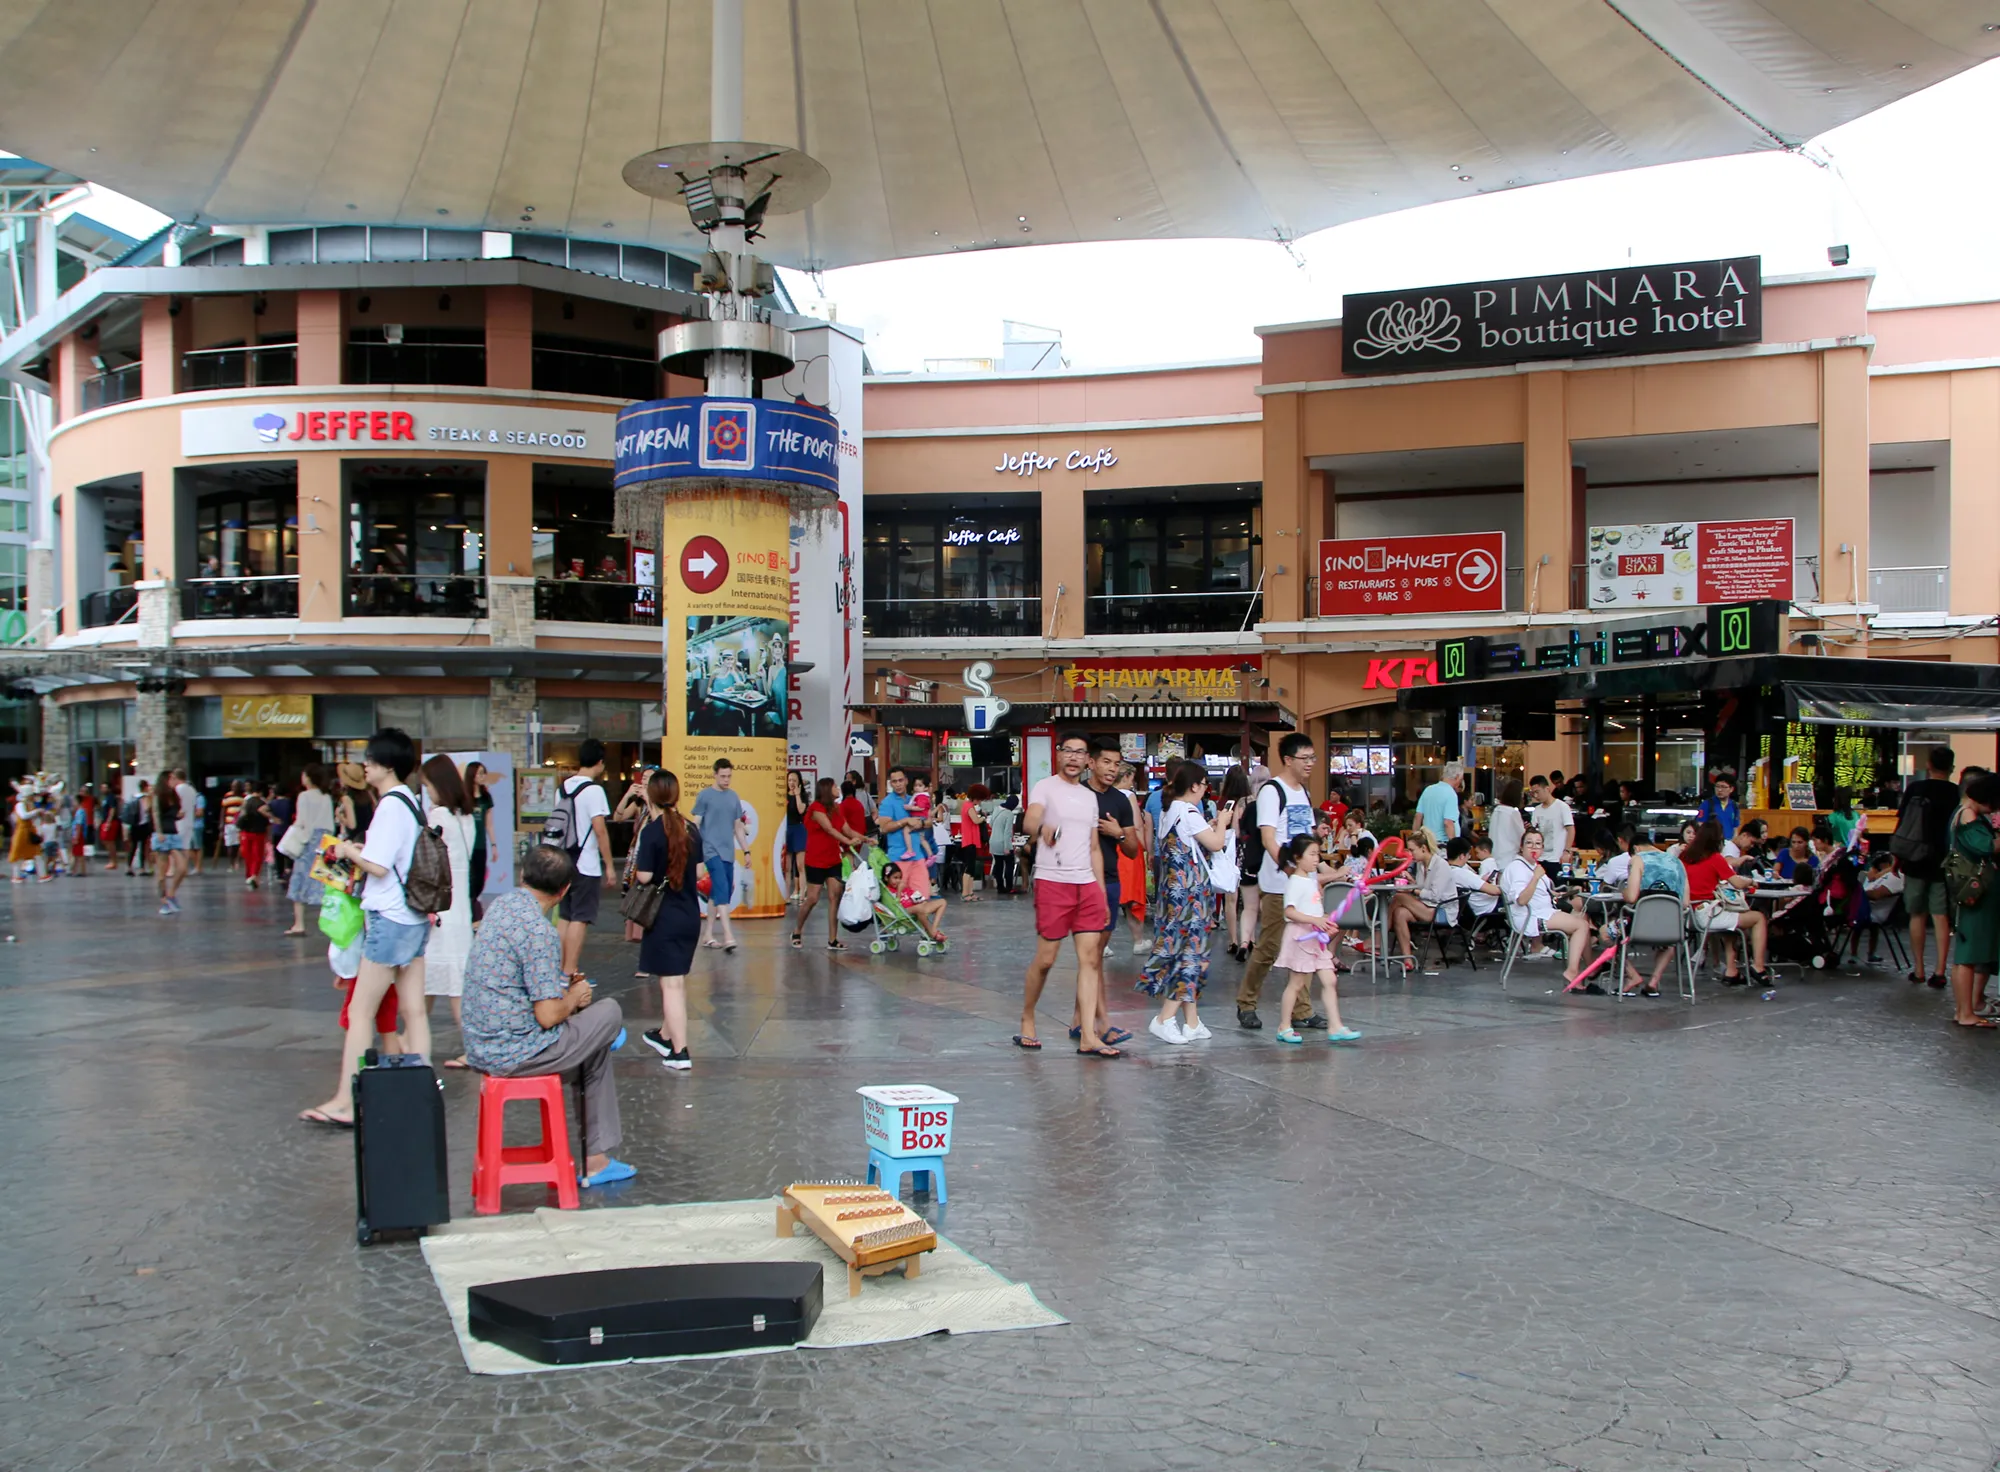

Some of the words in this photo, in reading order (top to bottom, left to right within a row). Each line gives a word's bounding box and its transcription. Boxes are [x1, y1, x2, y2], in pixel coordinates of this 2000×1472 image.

[1473, 265, 1749, 319] PIMNARA
[1478, 316, 1638, 349] boutique
[1652, 299, 1747, 335] hotel
[288, 410, 416, 441] JEFFER
[428, 426, 480, 442] STEAK
[488, 429, 499, 443] &
[505, 431, 587, 449] SEAFOOD
[636, 421, 690, 453] ARENA
[766, 429, 804, 453] THE
[804, 437, 834, 463] PORT
[838, 441, 858, 458] FFER
[995, 452, 1059, 476] Jeffer
[1065, 447, 1118, 473] Café
[943, 530, 984, 546] Jeffer
[987, 528, 1020, 545] Café
[1727, 533, 1750, 541] Largest
[736, 552, 765, 565] SINO
[1325, 556, 1364, 572] SINO
[1386, 552, 1457, 571] PHUKET
[1625, 556, 1657, 565] THAT'S
[1625, 563, 1657, 573] SIAM
[1338, 578, 1396, 590] RESTAURANTS
[1414, 577, 1439, 588] PUBS
[731, 589, 779, 601] International
[1377, 592, 1399, 601] BARS
[1083, 667, 1236, 689] SHAWARMA
[1186, 687, 1237, 697] EXPRESS
[787, 755, 817, 766] FFER
[898, 1107, 948, 1132] Tips
[902, 1130, 946, 1151] Box
